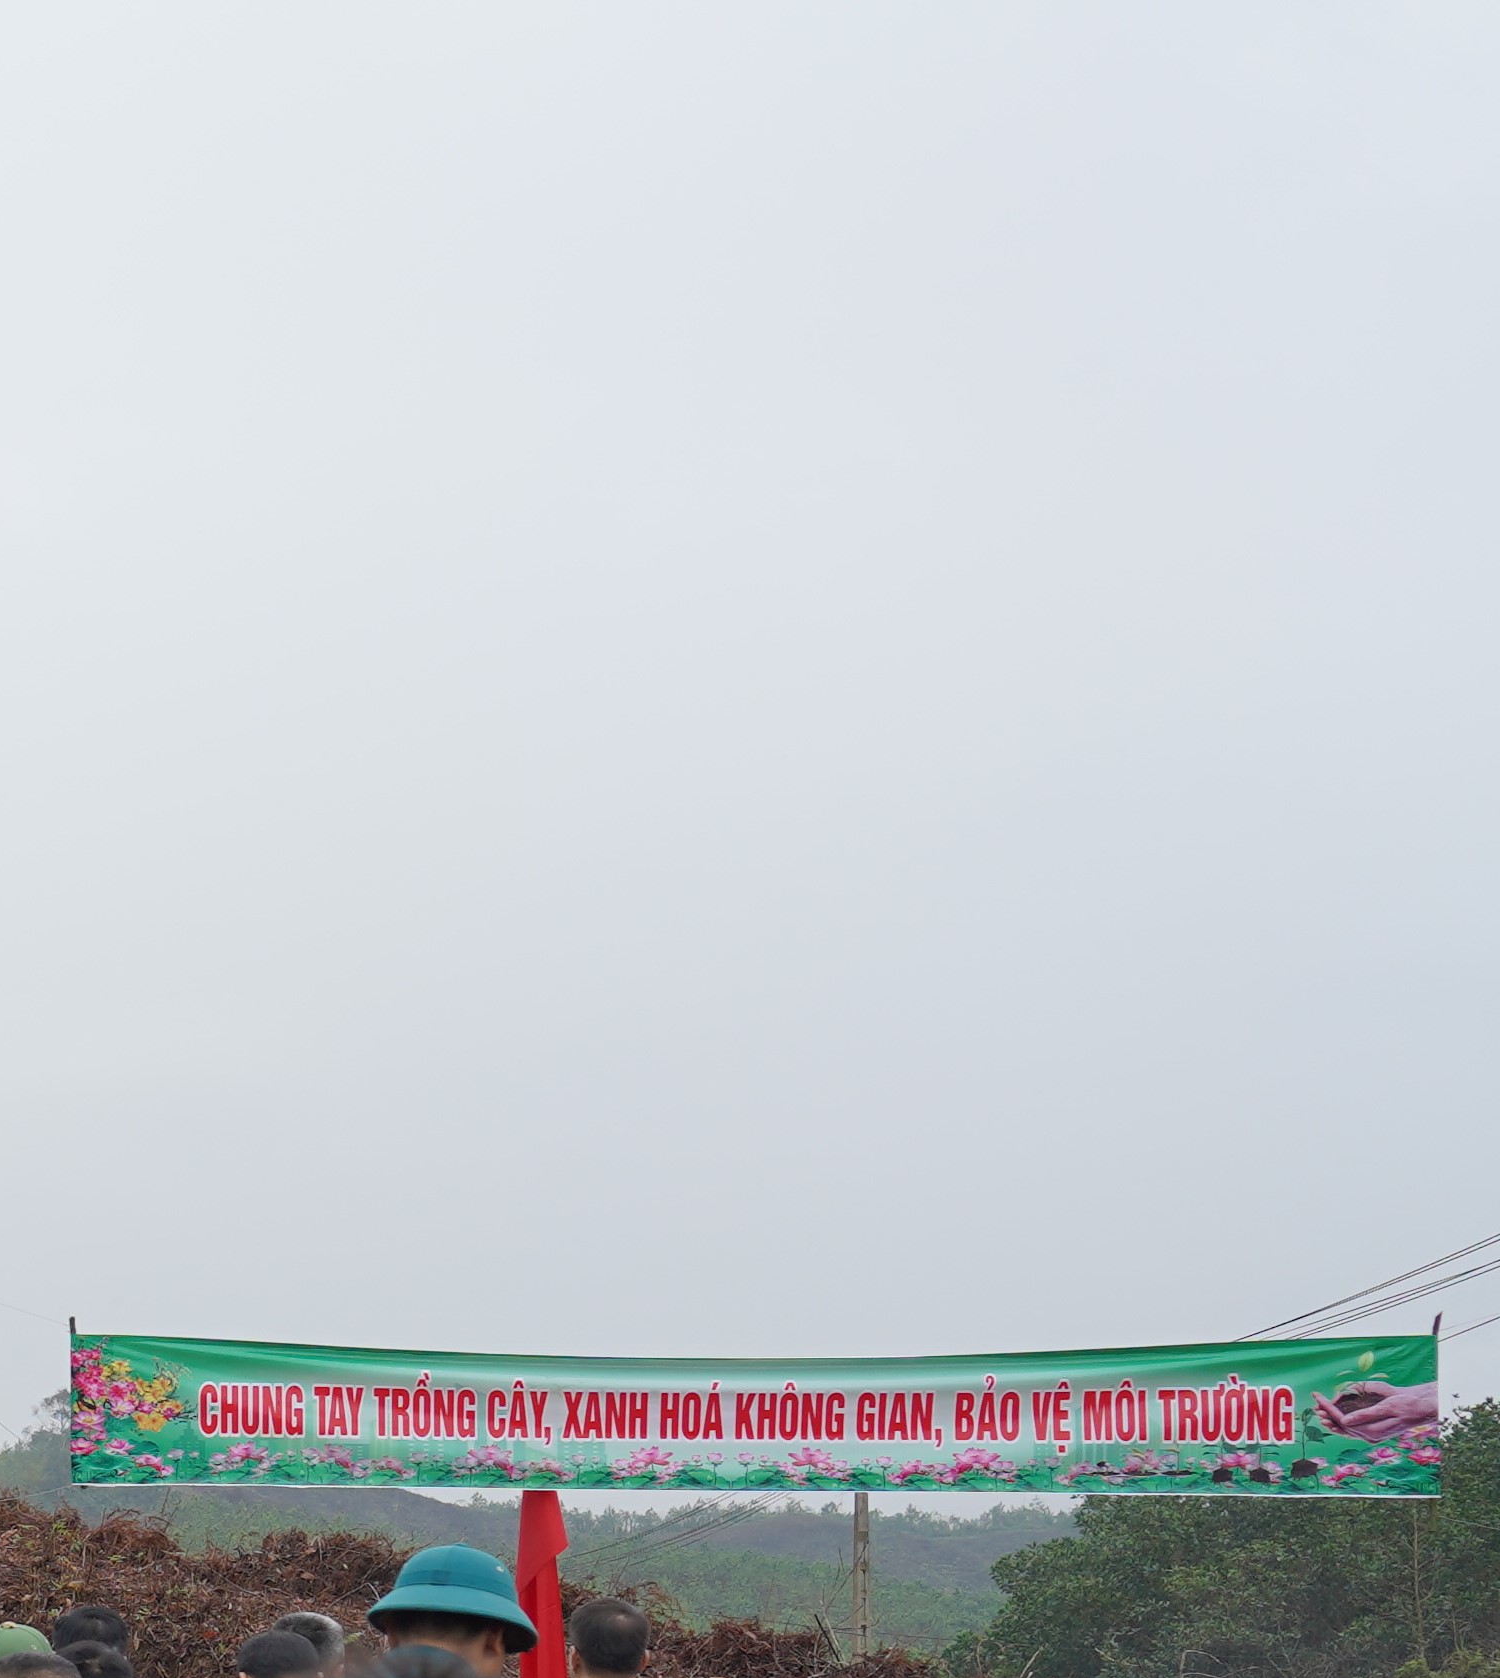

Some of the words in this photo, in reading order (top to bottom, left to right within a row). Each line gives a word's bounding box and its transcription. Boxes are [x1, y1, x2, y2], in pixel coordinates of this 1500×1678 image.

[200, 1384, 303, 1436] CHUNG
[314, 1385, 364, 1436] TAY
[374, 1373, 475, 1438] TRỒNG
[487, 1380, 551, 1445] CÂY,
[564, 1390, 649, 1439] XANH
[660, 1383, 723, 1440] HOÁ
[735, 1383, 845, 1441] KHÔNG
[857, 1392, 941, 1446] GIAN,
[955, 1376, 1020, 1441] BẢO
[1033, 1382, 1071, 1453] VỆ
[1083, 1381, 1146, 1441] MÔI
[1157, 1376, 1293, 1442] TRƯỜNG
